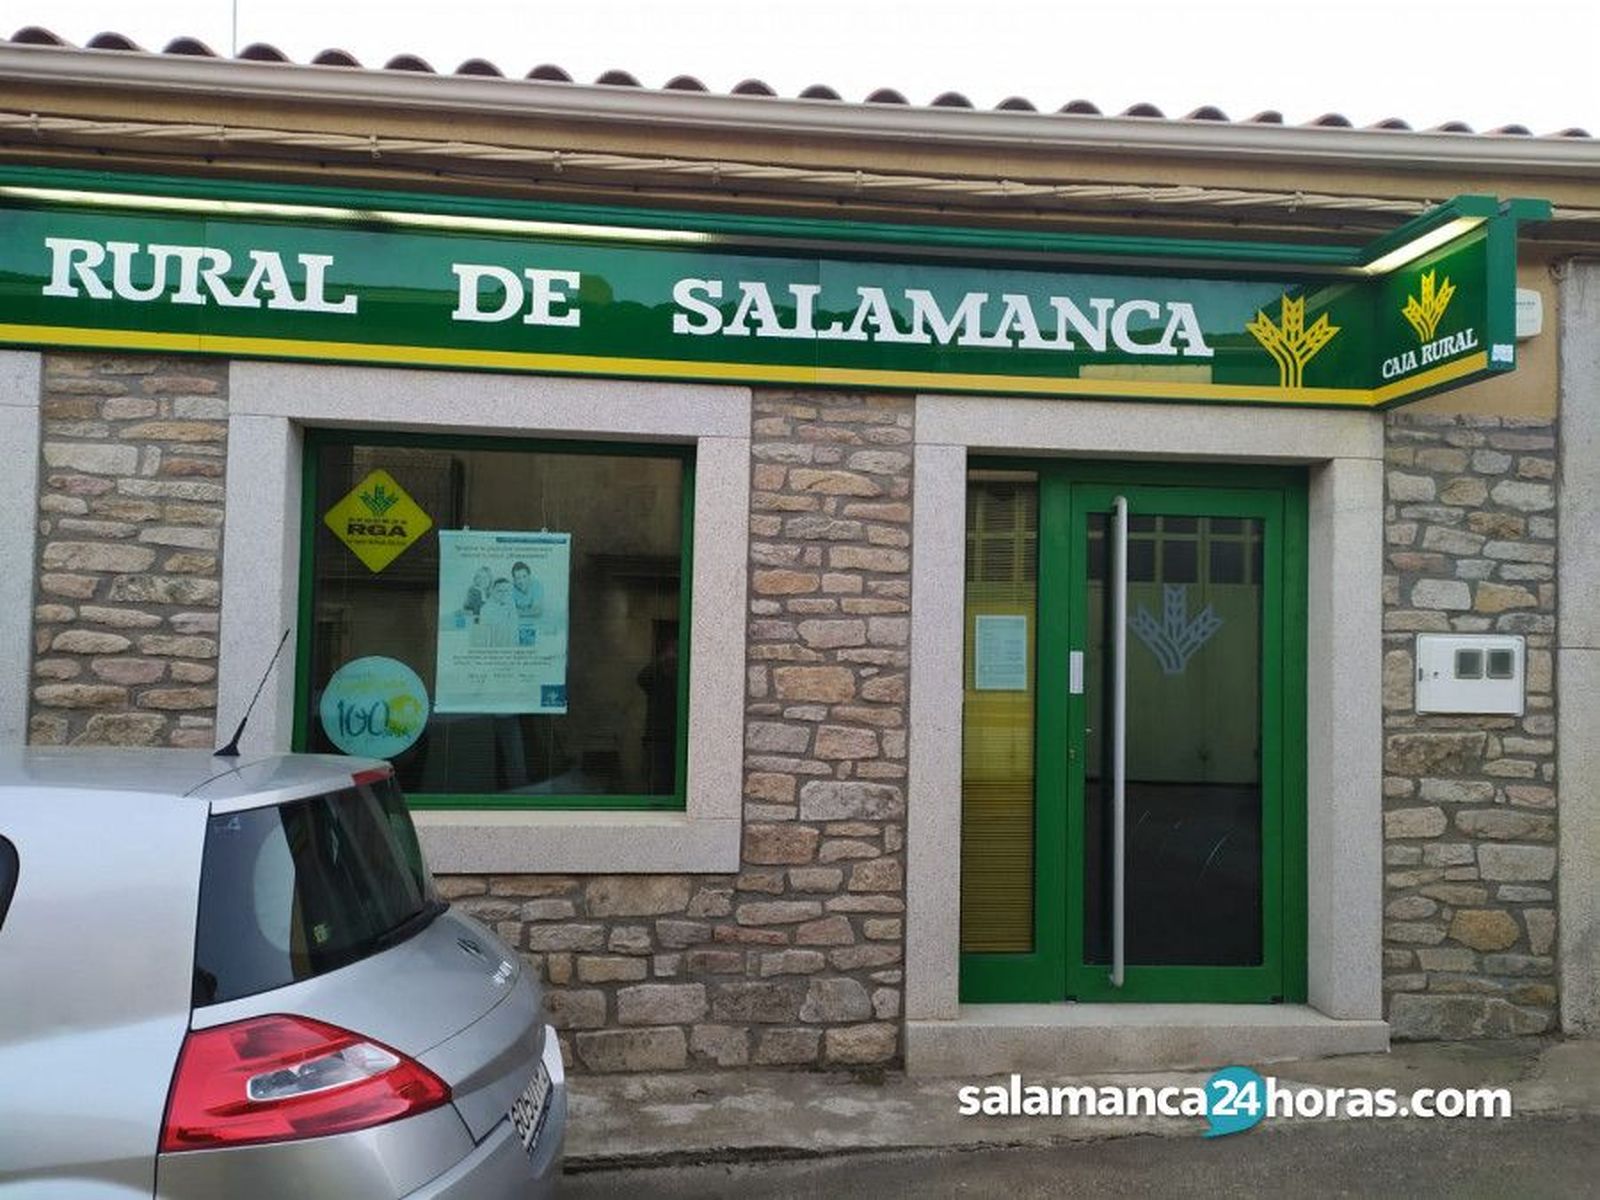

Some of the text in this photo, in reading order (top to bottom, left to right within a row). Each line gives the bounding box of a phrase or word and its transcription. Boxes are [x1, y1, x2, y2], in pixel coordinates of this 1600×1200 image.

[42, 236, 1215, 358] RURAL DE SALAMANCA
[1382, 328, 1478, 379] CAJA RURAL
[347, 523, 407, 537] RGA
